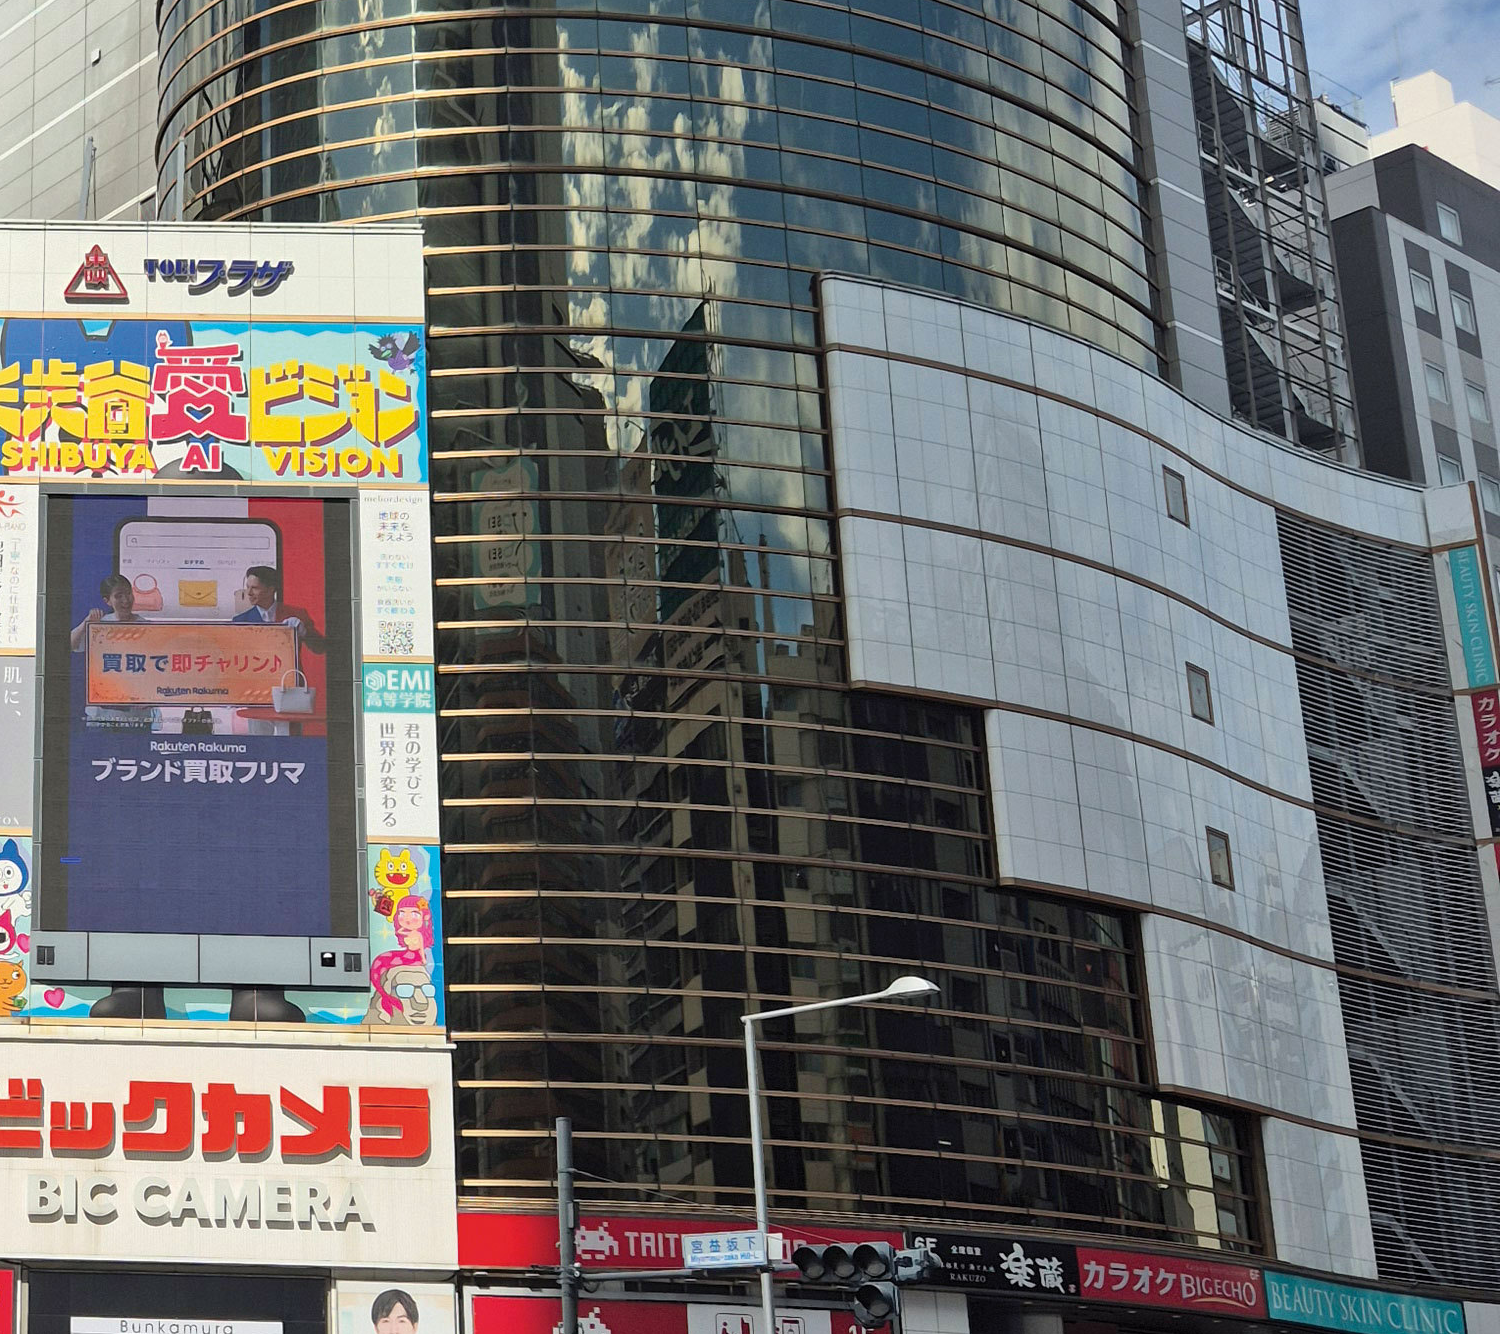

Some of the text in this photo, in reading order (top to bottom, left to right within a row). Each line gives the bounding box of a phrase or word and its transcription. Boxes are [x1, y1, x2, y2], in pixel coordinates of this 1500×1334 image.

[2, 441, 403, 477] SHIBUYA AI VISION
[378, 511, 410, 521] 地球の
[378, 522, 410, 532] 未来を
[376, 532, 415, 543] 考えよう
[1457, 549, 1489, 684] BEAUTY SKIN CLINIC
[156, 686, 229, 697] Rakuten Rakuma
[386, 669, 431, 692] EMI
[365, 692, 432, 709] 高等学院
[1477, 697, 1500, 762] カラオケ
[150, 741, 247, 755] Rakuten Rakuma
[91, 757, 306, 785] ブランド買取フリマ
[379, 722, 398, 828] 世界が変わる
[403, 722, 424, 808] 君の学びで
[27, 1174, 376, 1232] BIC CAMERA
[624, 1231, 683, 1259] TAIT
[691, 1234, 756, 1254] 宮益坂下
[950, 1273, 987, 1284] RAKUZO
[1000, 1242, 1066, 1294] 楽蔵
[1083, 1260, 1261, 1296] カラオケ 6F
[1270, 1280, 1335, 1319] BEAUTY
[1339, 1293, 1384, 1327] SKIN
